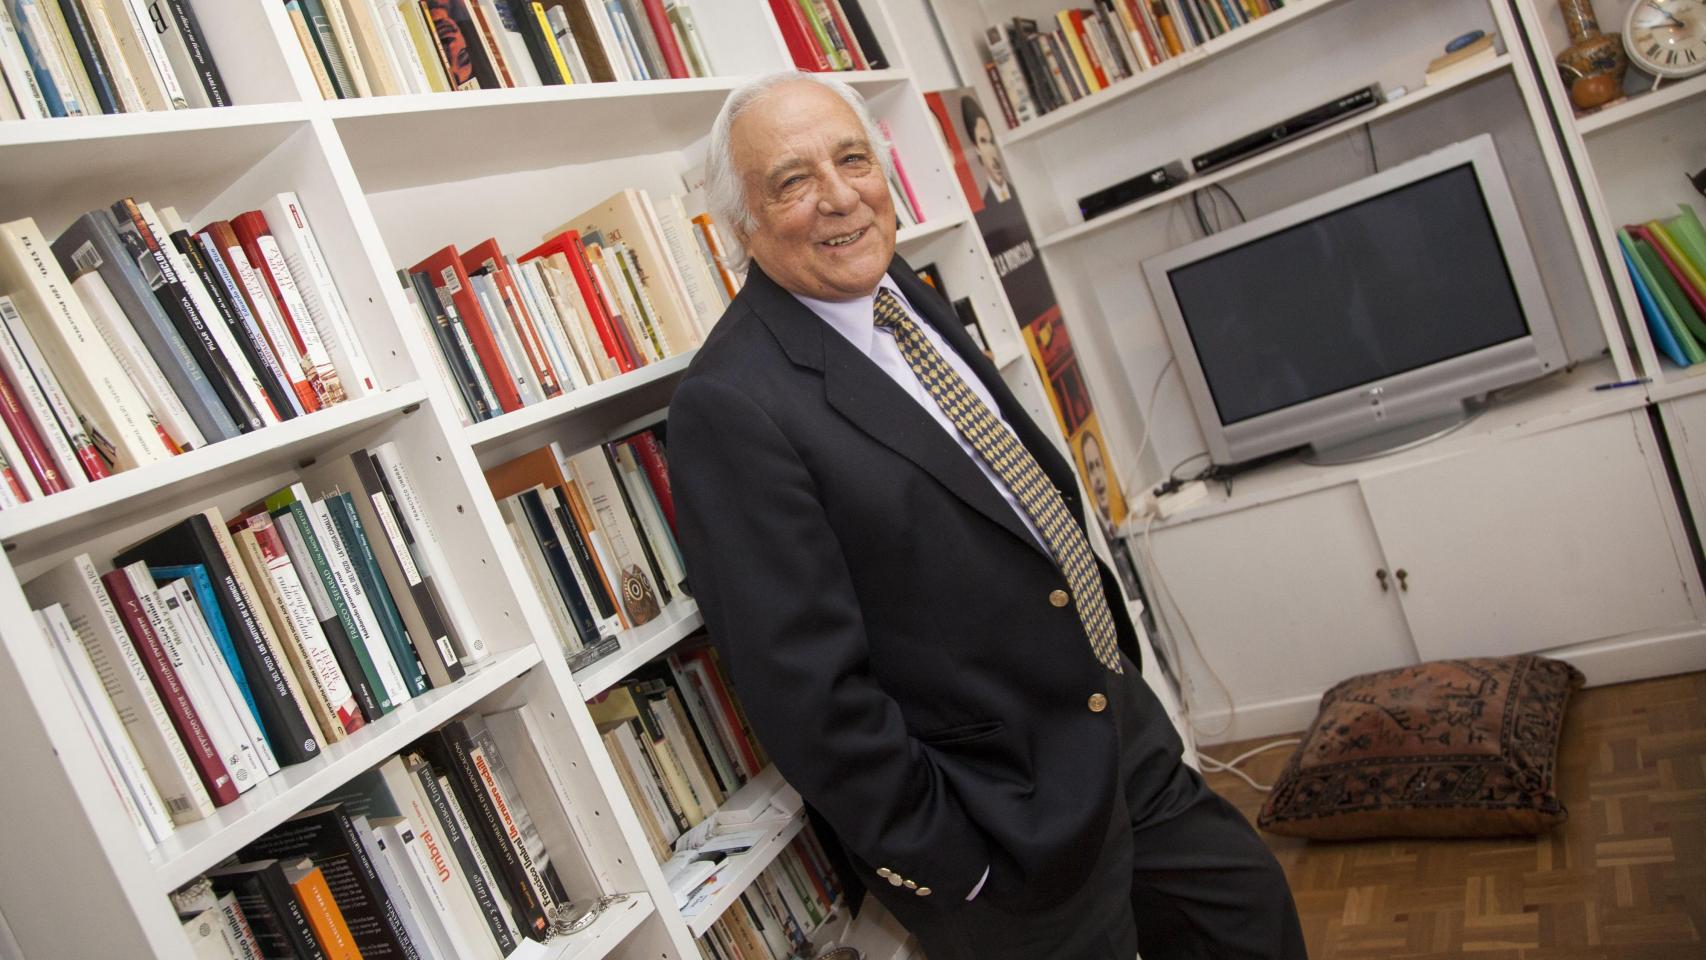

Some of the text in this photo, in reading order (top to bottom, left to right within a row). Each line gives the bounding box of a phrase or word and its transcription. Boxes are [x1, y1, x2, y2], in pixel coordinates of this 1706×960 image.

[175, 3, 183, 14] sus
[187, 33, 195, 42] su
[190, 40, 206, 65] tiempo
[20, 234, 33, 249] EL
[208, 247, 220, 263] Rico
[152, 249, 178, 285] MONCLOA
[201, 270, 212, 284] rubia
[240, 259, 264, 300] ALCARAZ
[265, 254, 285, 287] FELIPE
[269, 245, 296, 292] ALCARAZ
[208, 282, 220, 297] mujer
[231, 289, 250, 317] Eduardo
[180, 295, 216, 351] PILAR CERNUDA
[223, 308, 231, 318] azar
[391, 463, 421, 521] FRANCISCO UMBRAL
[319, 512, 334, 535] CANALLA
[308, 534, 320, 552] AMOR
[329, 534, 341, 551] PROSA
[336, 549, 344, 558] LA
[333, 570, 343, 583] mal
[340, 559, 351, 573] POZO
[346, 572, 356, 583] DEL
[81, 563, 109, 608] HENARES
[223, 574, 242, 603] MONCLOA
[322, 567, 342, 601] SEFARAD
[341, 586, 357, 609] pronto
[150, 590, 165, 610] rosa
[236, 600, 245, 610] LA
[240, 608, 249, 618] DE
[276, 574, 294, 600] ruido
[291, 606, 314, 641] soledad
[287, 582, 316, 626] Tiempo de
[337, 600, 345, 608] Y
[136, 615, 162, 658] MEMORIAS
[138, 592, 183, 668] Francisco Umbral
[162, 616, 182, 646] Mortal
[244, 616, 262, 644] CAUTIVOS
[339, 606, 359, 639] FRANCO
[350, 608, 370, 639] Hablando
[117, 634, 147, 682] ANTONIO
[257, 642, 267, 654] LOS
[276, 596, 336, 719] YO SOY TODOS LOS BESOS QUE NUNCA PUDE DARTE
[262, 654, 275, 671] POZO
[270, 669, 280, 682] DEL
[308, 645, 337, 693] ALCARAZ
[318, 647, 342, 683] FELIPE
[473, 754, 494, 788] cuchillo
[420, 767, 460, 842] Francisco Umbral
[443, 783, 470, 830] Francisco Umbral
[476, 792, 485, 803] DE
[488, 786, 512, 826] carnívoro
[340, 814, 350, 828] RICO
[481, 802, 495, 823] CITAS
[468, 835, 479, 852] Nada
[491, 822, 508, 852] MEJORES
[506, 824, 518, 838] Un
[418, 828, 452, 882] Umbral
[504, 851, 514, 865] LAS
[512, 836, 533, 869] Umbral
[526, 866, 551, 907] Francisco
[483, 899, 491, 908] el
[220, 904, 244, 939] Umbral
[229, 900, 254, 940] del dolor
[286, 899, 316, 948] LUIS GARCI
[383, 898, 410, 944] DE LA MANCHA
[491, 915, 503, 933] rosa
[498, 933, 510, 947] La
